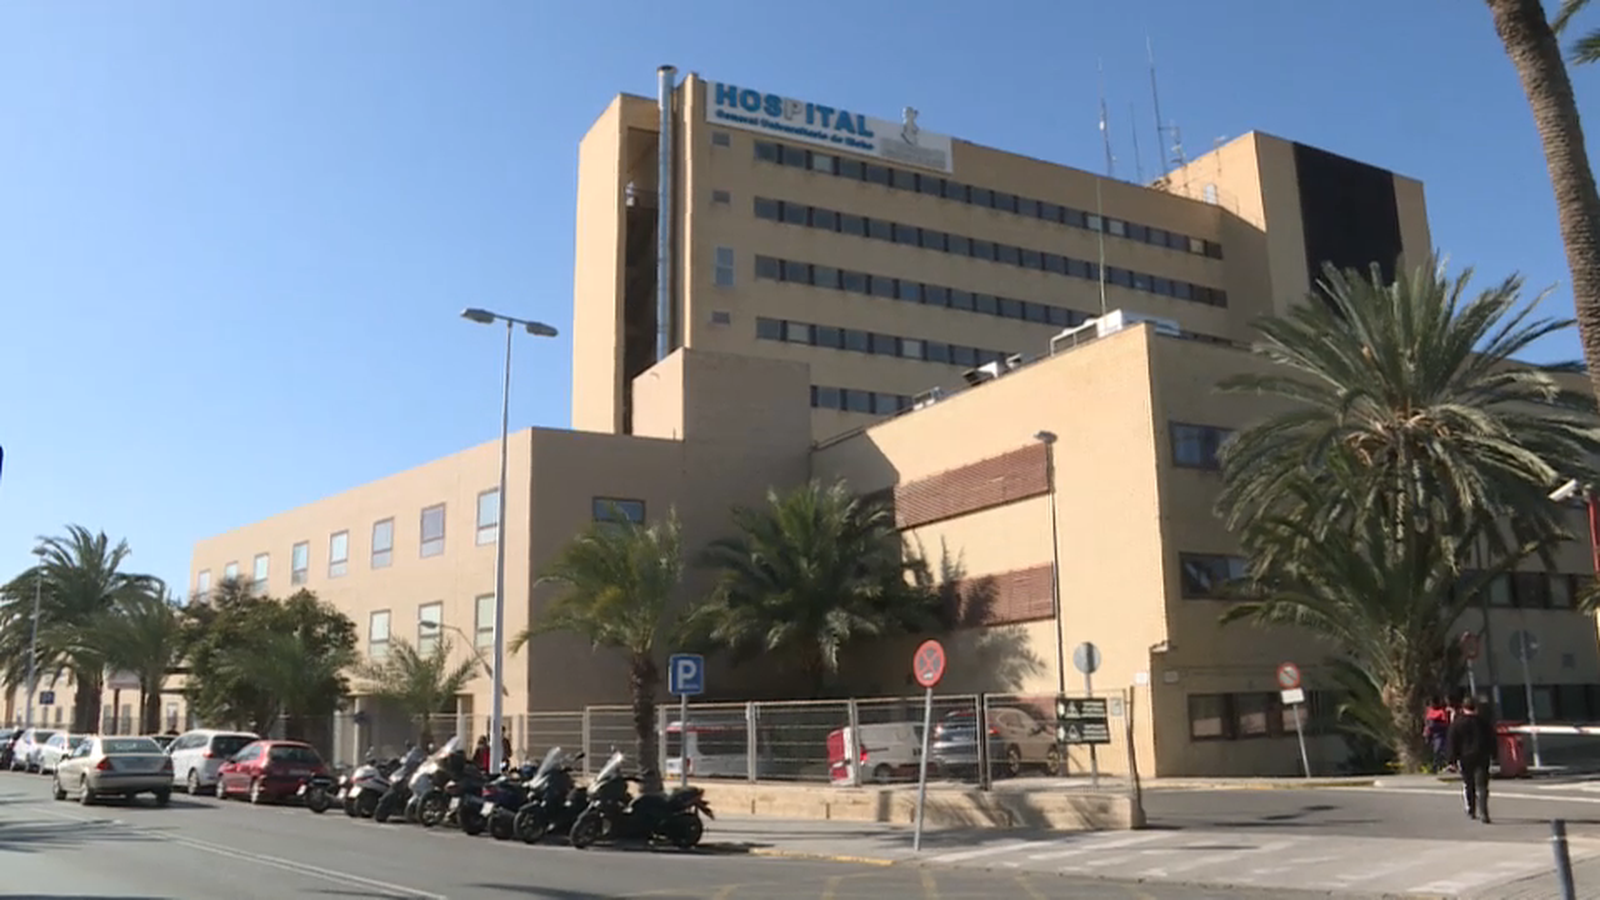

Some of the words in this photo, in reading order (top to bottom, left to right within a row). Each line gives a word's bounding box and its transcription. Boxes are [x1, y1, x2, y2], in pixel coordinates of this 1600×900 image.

[715, 82, 874, 138] HOSPITAL
[716, 109, 759, 126] General
[760, 117, 828, 139] Universitario
[677, 659, 697, 690] P
